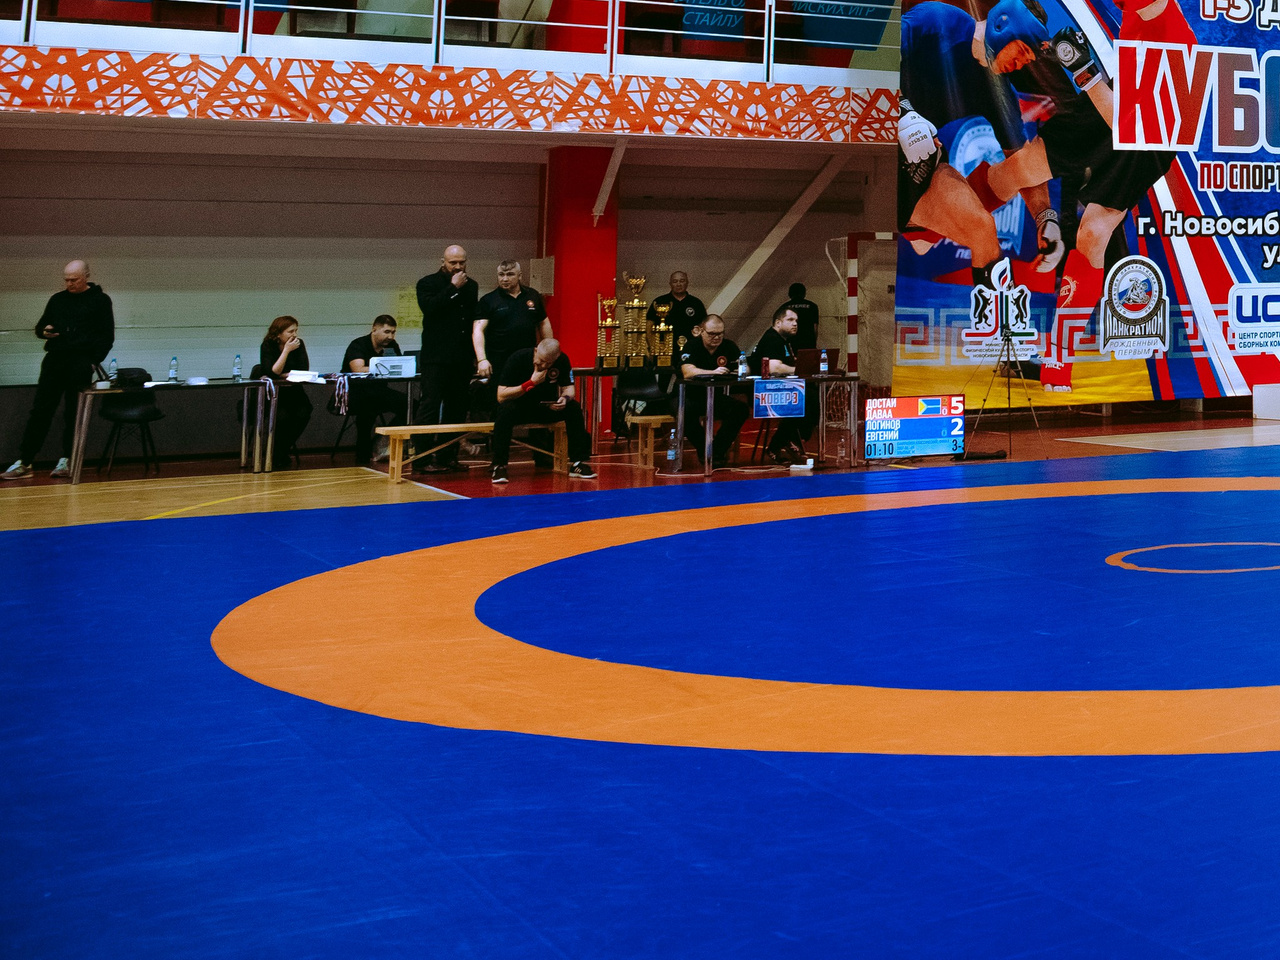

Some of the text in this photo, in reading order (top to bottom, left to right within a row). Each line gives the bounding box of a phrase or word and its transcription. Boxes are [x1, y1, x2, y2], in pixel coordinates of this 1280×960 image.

[682, 11, 743, 28] СТАЙЛУ
[1198, 162, 1226, 192] ПО
[1138, 216, 1156, 234] г.
[1106, 303, 1164, 337] ПАНКРАТИОН
[1238, 332, 1258, 340] ЦЕНТР
[1110, 339, 1159, 348] РОЖДЕННЫЙ
[1238, 340, 1269, 349] СБОРНЫХ
[1118, 348, 1151, 356] ПЕРВЫМ
[760, 392, 798, 405] КОВЕР 3
[950, 396, 964, 414] 5
[866, 409, 893, 421] ДАВАА
[866, 417, 964, 435] ЛОГИНОВ 2
[866, 429, 899, 442] ЕВГЕНИЙ
[866, 442, 894, 456] 01:10
